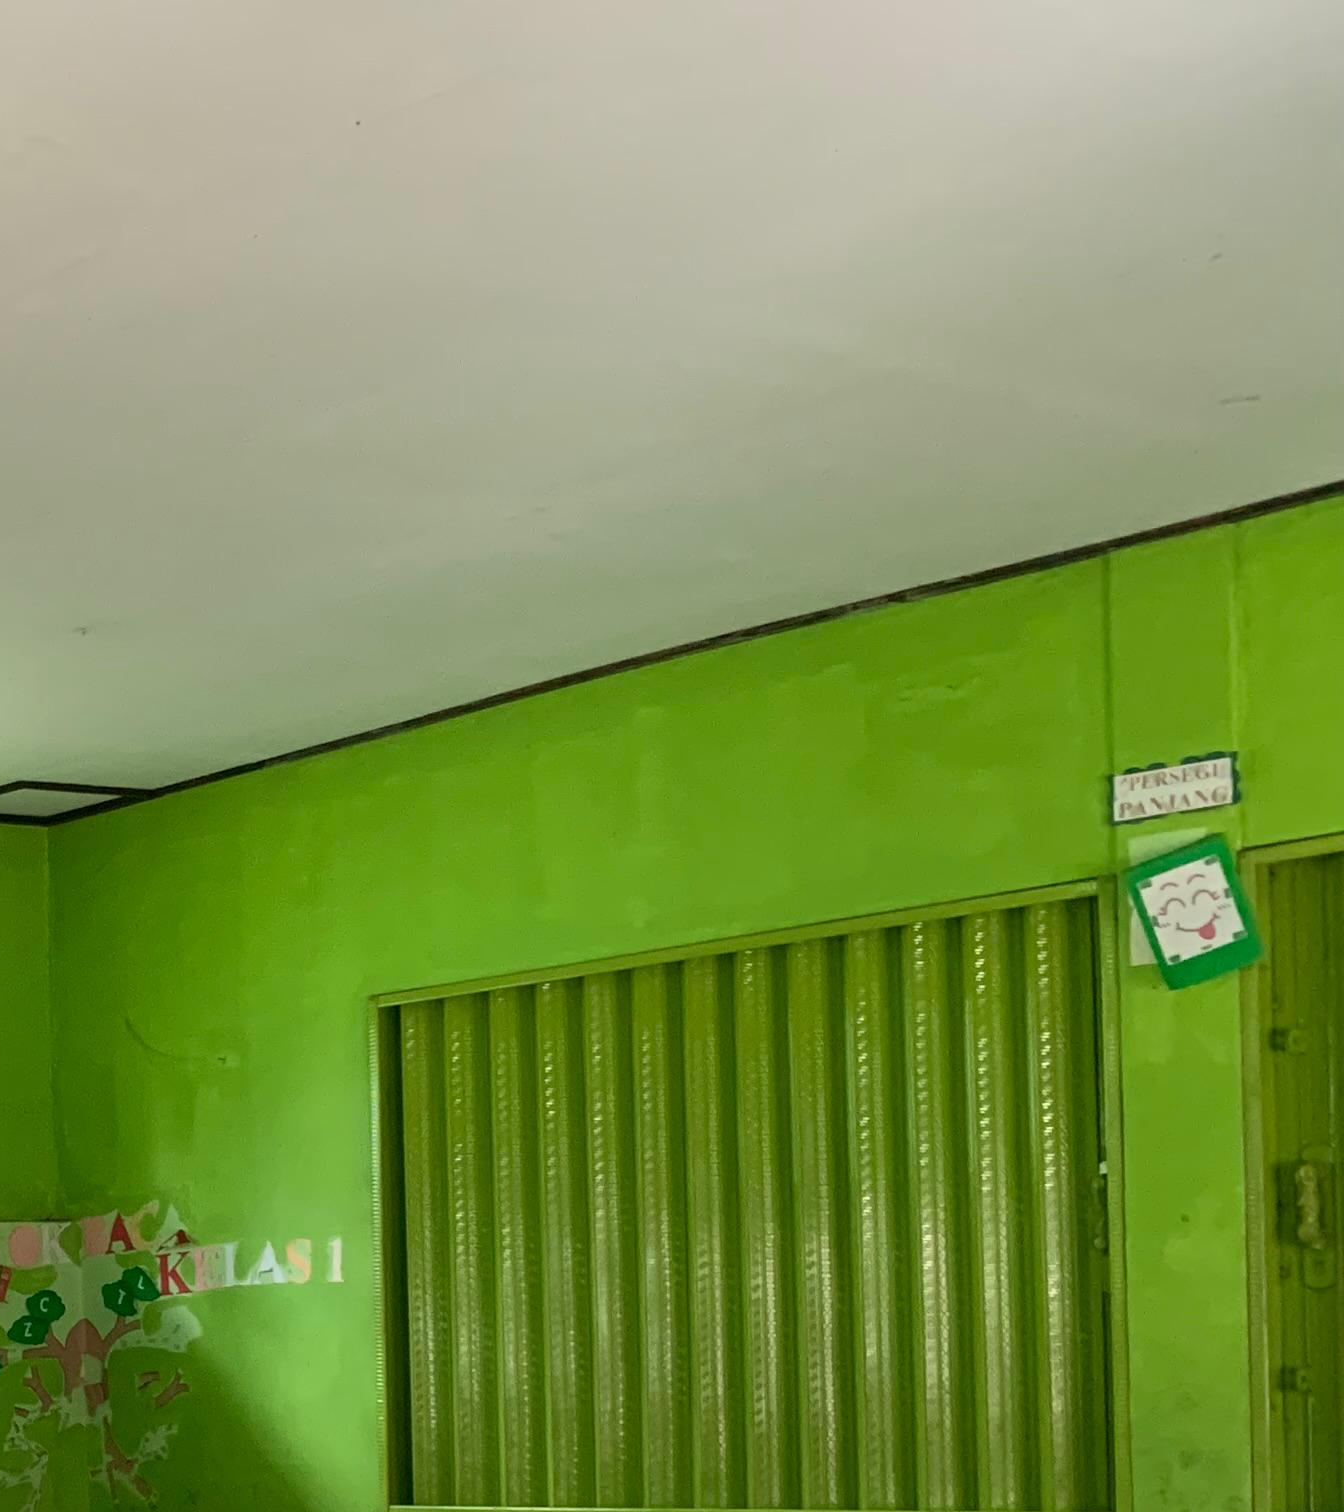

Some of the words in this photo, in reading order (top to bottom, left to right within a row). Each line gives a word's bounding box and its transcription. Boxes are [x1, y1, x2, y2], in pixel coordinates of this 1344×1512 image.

[327, 1237, 345, 1283] 1
[39, 1297, 50, 1313] C
[23, 1322, 33, 1337] Z
